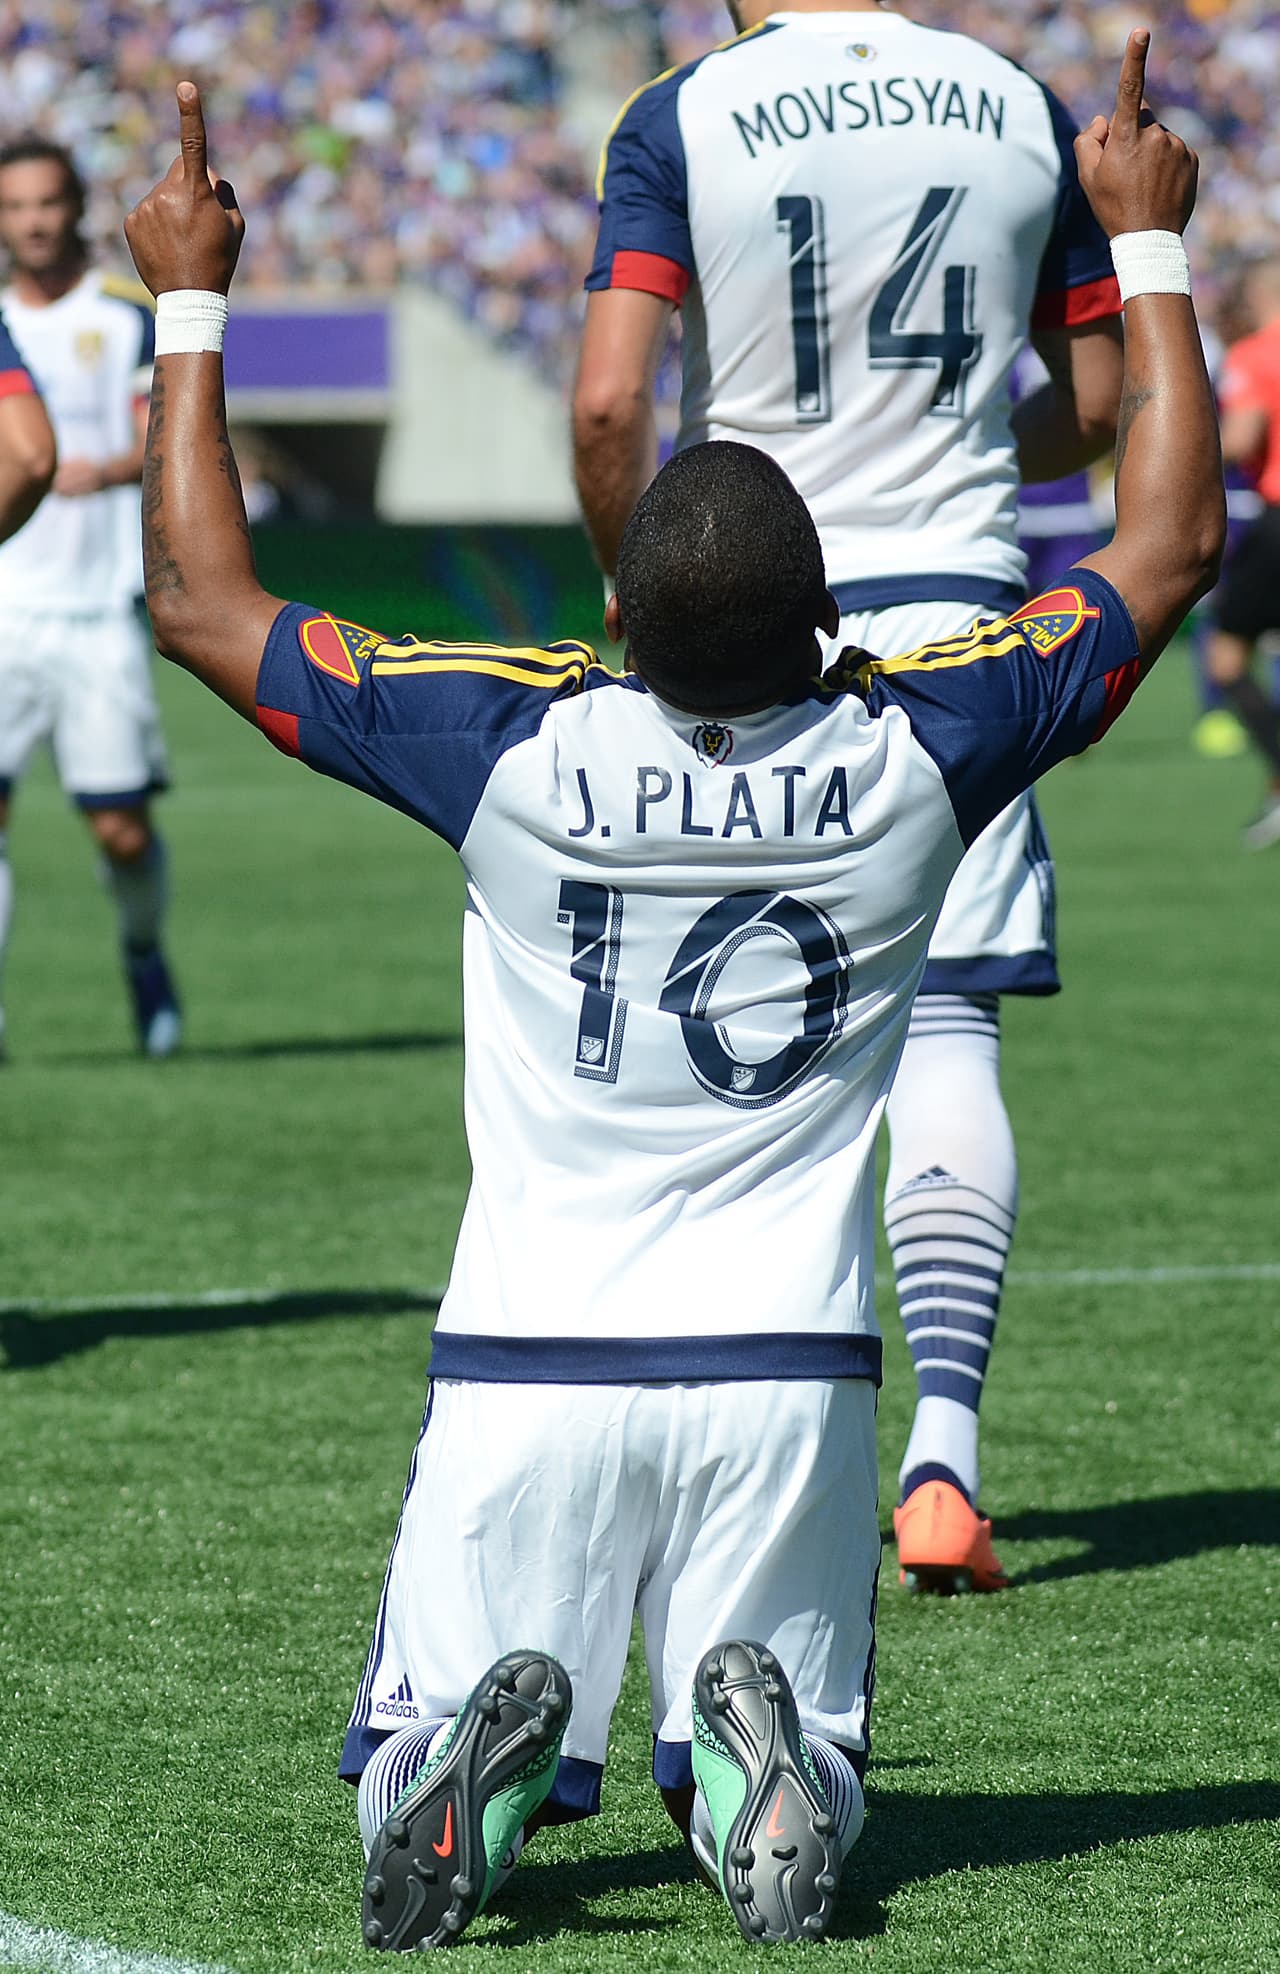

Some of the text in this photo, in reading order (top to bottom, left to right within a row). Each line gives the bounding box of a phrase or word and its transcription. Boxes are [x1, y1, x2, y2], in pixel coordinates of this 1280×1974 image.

[731, 77, 1005, 159] MOVSISYAN
[775, 185, 983, 424] 14
[355, 635, 384, 660] MLS
[1022, 620, 1057, 647] MLS
[568, 766, 854, 838] J. PLATA
[556, 878, 855, 1110] 10
[376, 1700, 419, 1719] adidas
